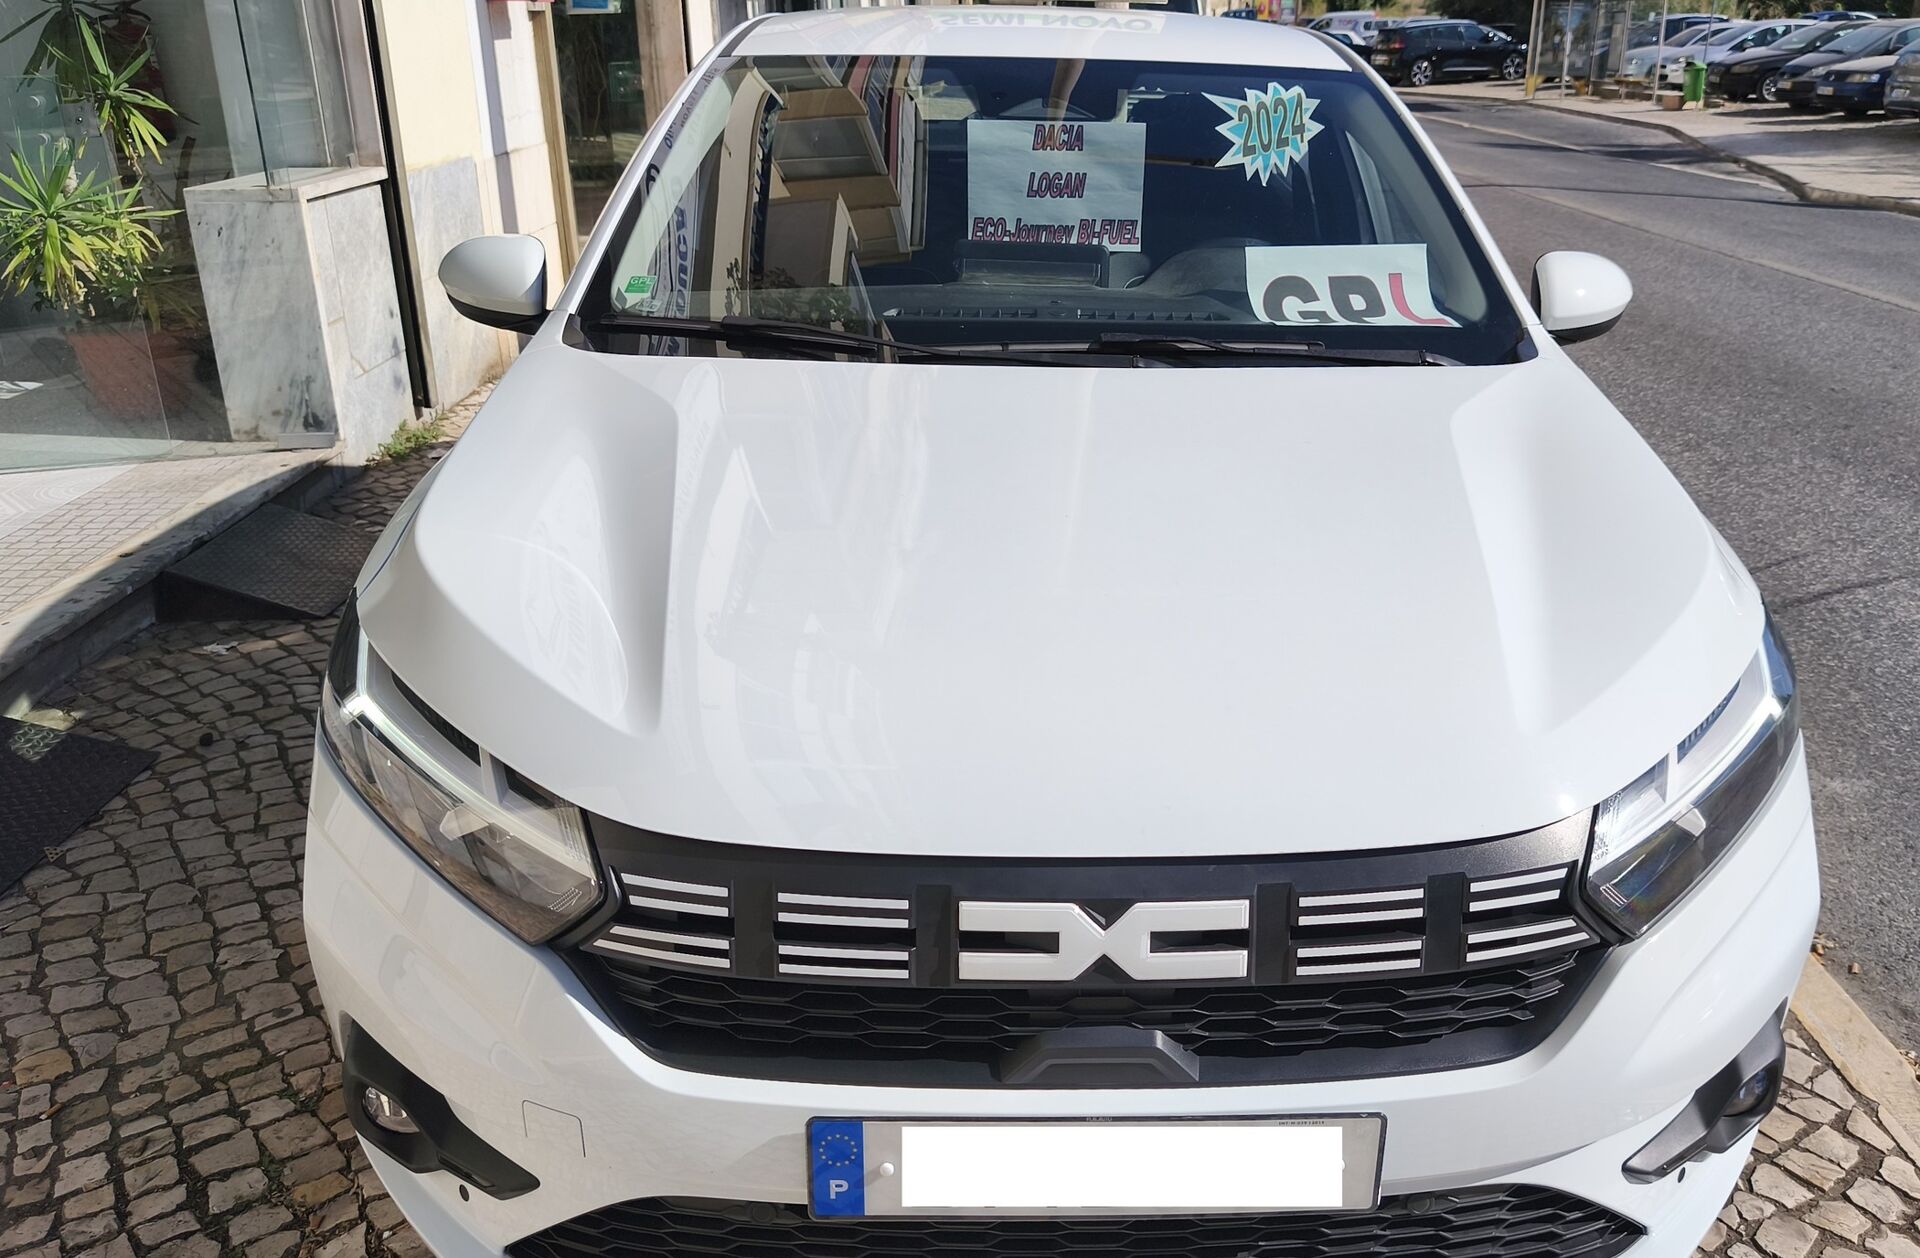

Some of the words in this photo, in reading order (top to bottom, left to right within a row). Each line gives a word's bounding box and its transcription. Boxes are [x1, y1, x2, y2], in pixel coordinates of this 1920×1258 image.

[1032, 124, 1084, 151] DACIA
[1238, 93, 1307, 157] 2024
[1027, 172, 1087, 198] LOGAN
[972, 217, 1075, 244] ECO-Journey
[1078, 219, 1139, 245] BI-FUEL
[630, 277, 653, 285] GPL
[1263, 273, 1451, 326] GPL
[829, 1179, 849, 1199] P
